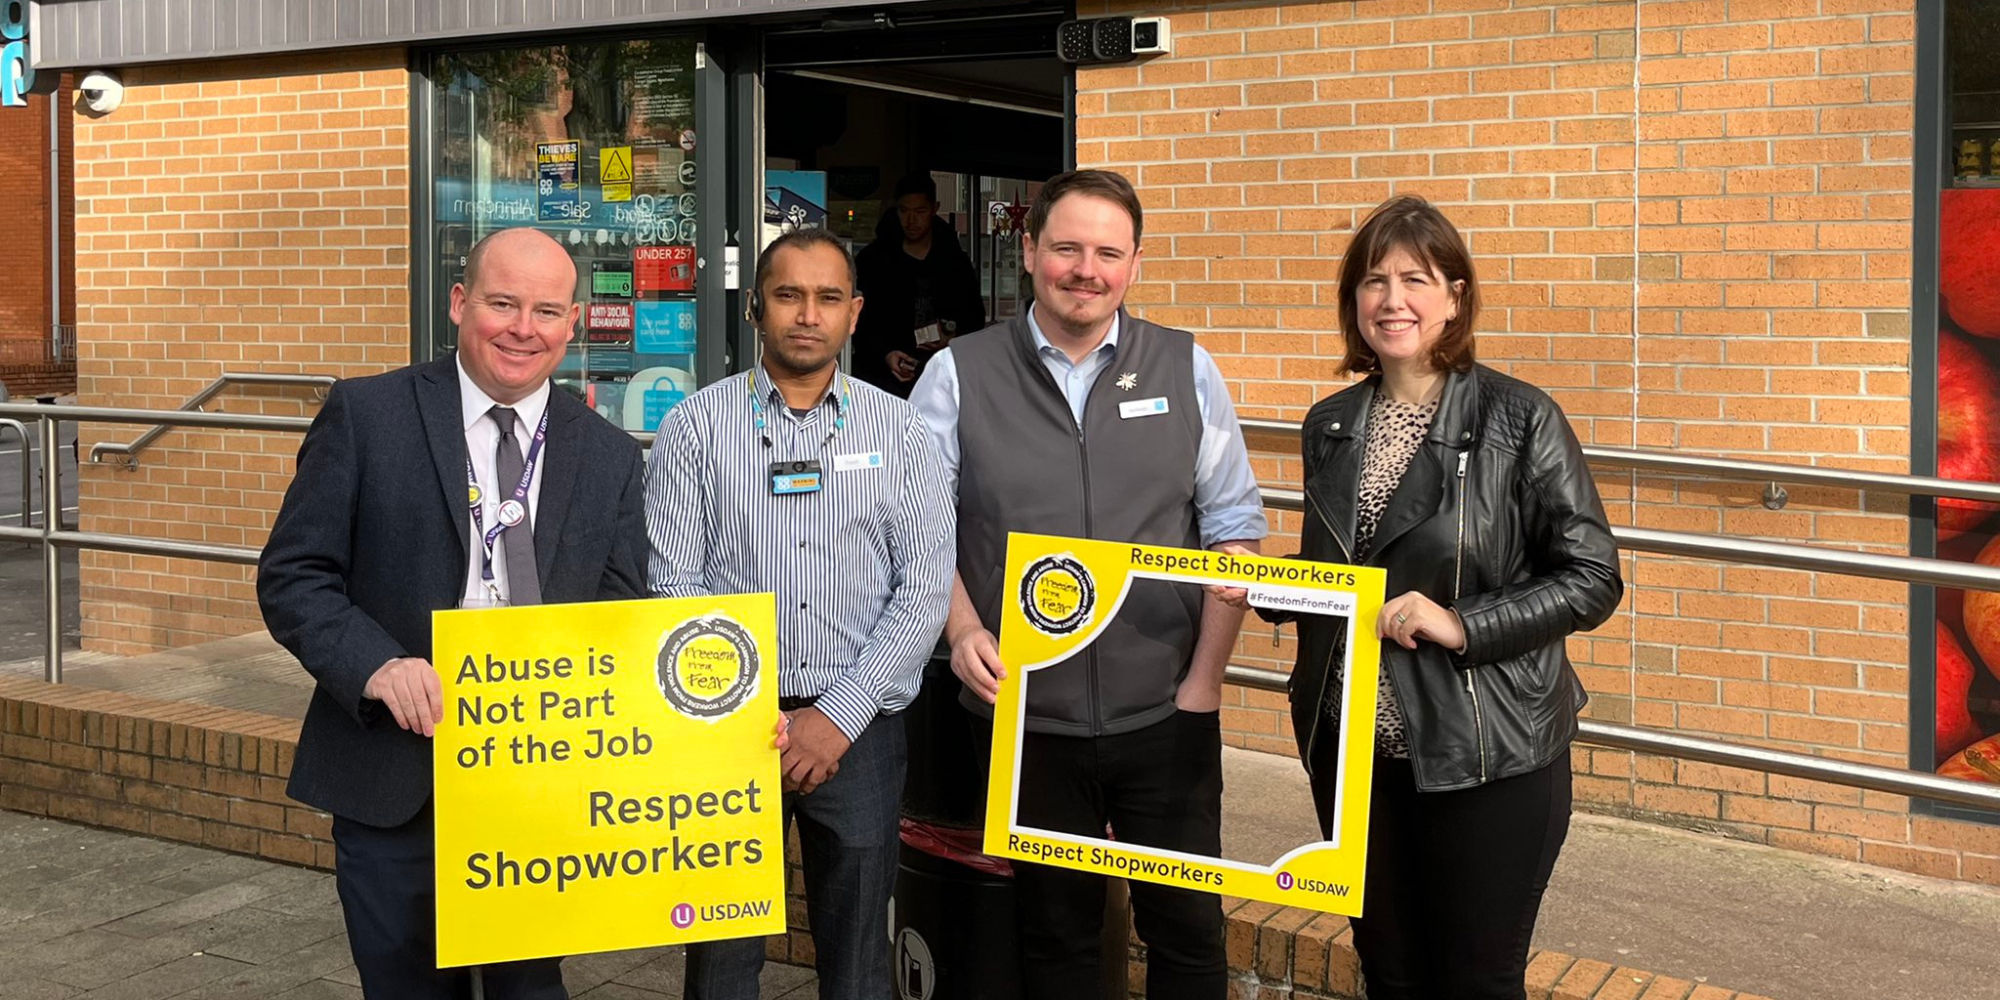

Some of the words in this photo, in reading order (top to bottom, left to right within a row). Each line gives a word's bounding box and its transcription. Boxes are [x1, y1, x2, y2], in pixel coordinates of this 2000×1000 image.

[538, 144, 577, 154] THIEVES
[538, 153, 577, 164] BEWARE
[636, 249, 672, 260] UNDER
[674, 248, 692, 260] 25?
[590, 306, 630, 317] ANTI-SOCIAL
[590, 318, 630, 328] BEHAVIOUR
[520, 459, 534, 488] USDAW
[1130, 548, 1209, 572] Respect
[1216, 556, 1356, 586] Shopworkers
[1040, 598, 1072, 615] Fear
[1250, 592, 1350, 612] #FreedomFromFear
[680, 626, 700, 642] ABUSE
[671, 640, 681, 656] AND
[455, 653, 574, 686] Abuse
[588, 646, 616, 676] is
[666, 654, 675, 688] VIOLENCE
[686, 674, 730, 690] Fear
[740, 675, 749, 686] TO
[672, 684, 687, 703] FROM
[720, 685, 745, 708] PROTECT
[458, 694, 530, 727] Not
[540, 688, 616, 722] Part
[686, 700, 720, 710] WORKERS
[456, 736, 496, 769] of
[508, 735, 572, 764] the
[584, 726, 654, 760] Job
[590, 778, 762, 831] Respect
[465, 836, 764, 892] Shopworkers
[1008, 834, 1084, 862] Respect
[1090, 848, 1224, 886] Shopworkers
[1297, 878, 1350, 898] USDAW
[700, 900, 772, 923] USDAW
